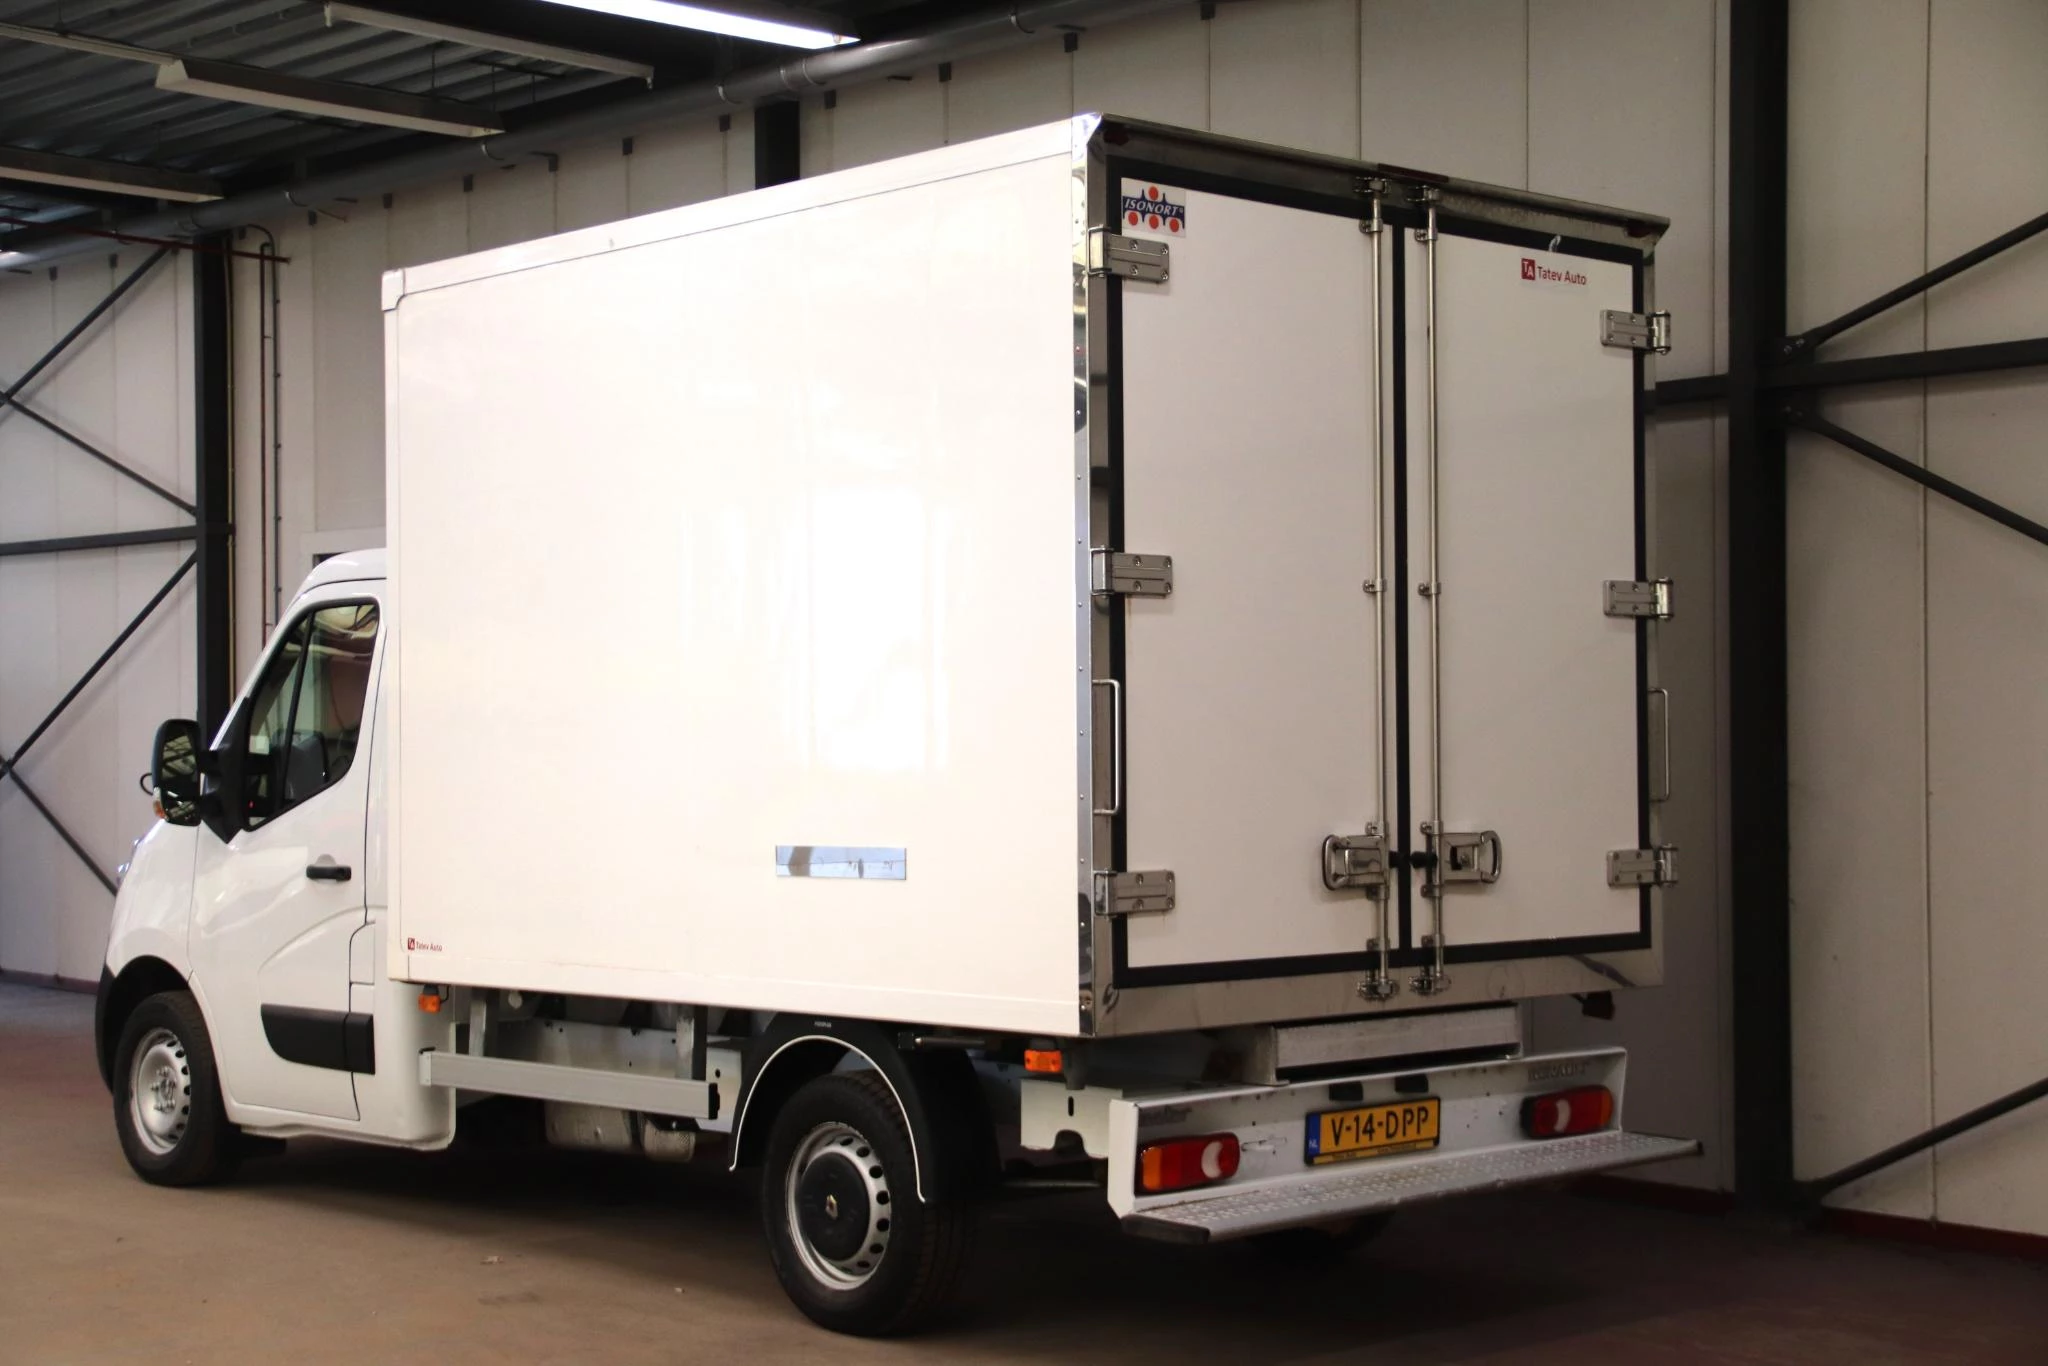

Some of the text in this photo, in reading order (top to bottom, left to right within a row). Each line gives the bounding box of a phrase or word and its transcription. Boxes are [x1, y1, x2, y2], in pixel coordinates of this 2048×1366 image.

[1537, 265, 1562, 282] Tatev
[1564, 270, 1587, 286] Auto
[1331, 1106, 1429, 1147] V-14-DPP
